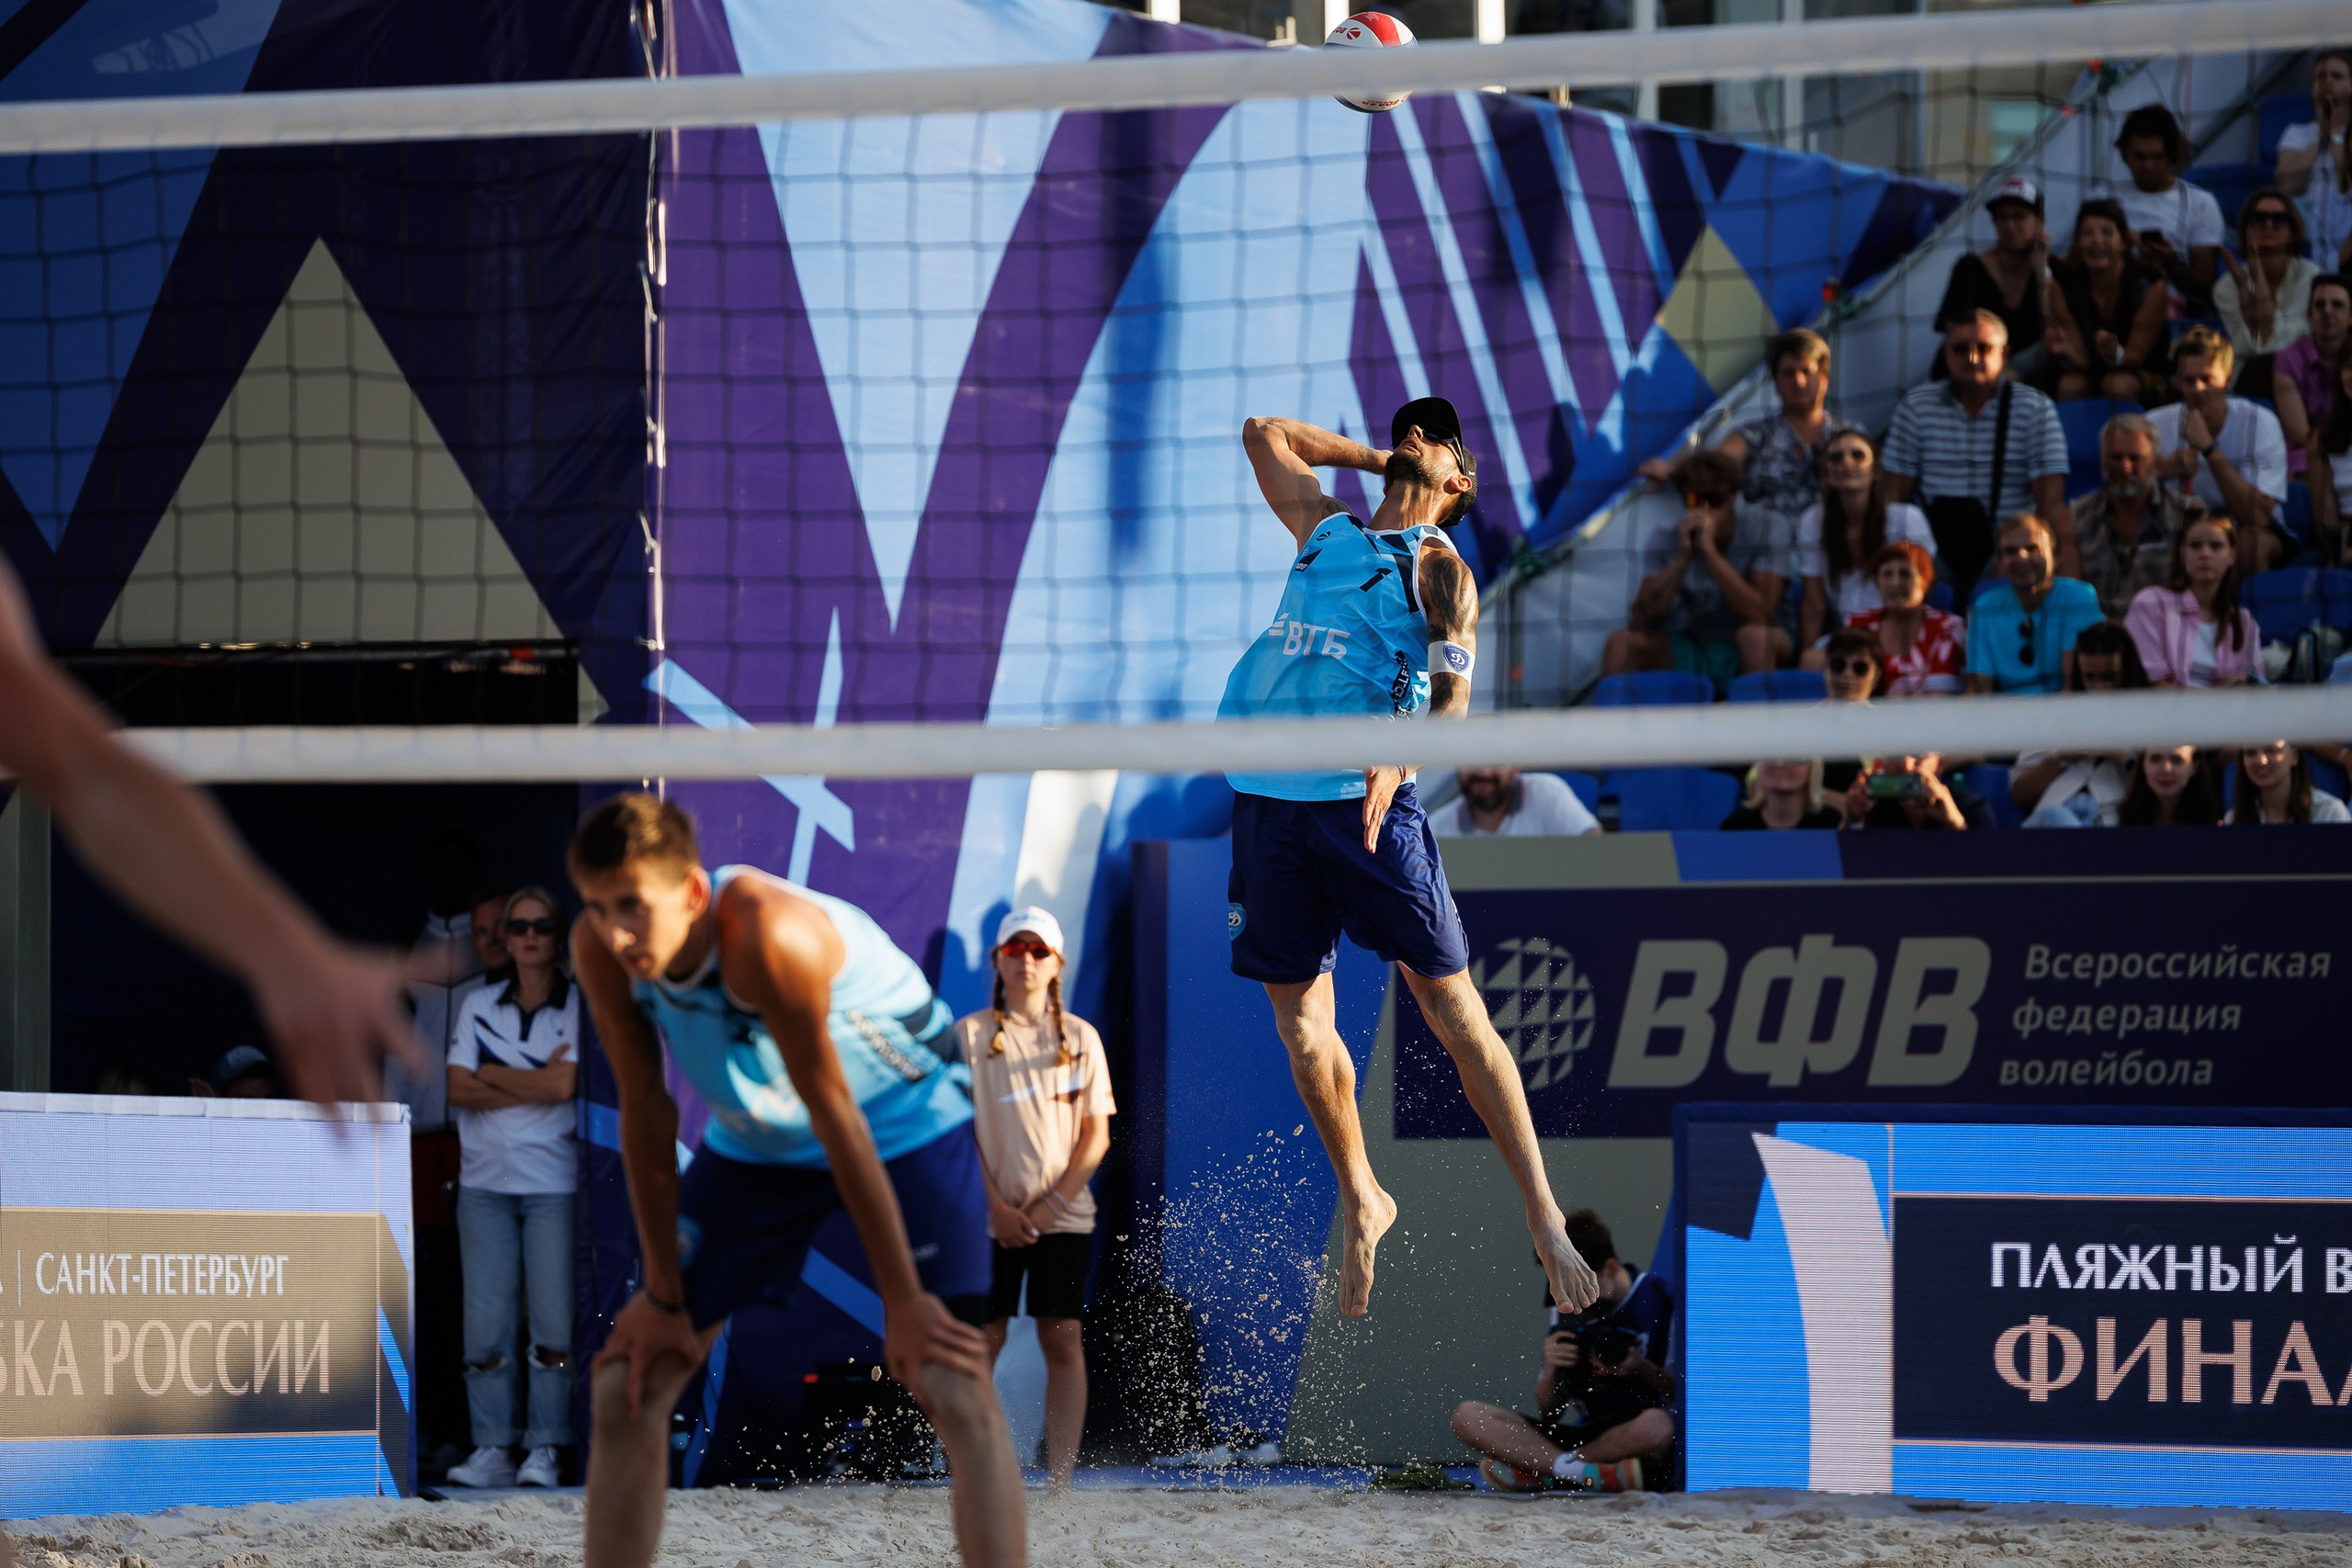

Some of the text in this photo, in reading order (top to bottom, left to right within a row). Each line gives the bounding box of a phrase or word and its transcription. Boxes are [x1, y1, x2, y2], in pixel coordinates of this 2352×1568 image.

[1359, 568, 1393, 592] 1
[1283, 621, 1351, 660] ВТБ
[2024, 944, 2332, 987] Всероссийская
[1607, 934, 1991, 1088] ВФВ
[2012, 998, 2243, 1039] федерация
[1998, 1049, 2214, 1086] волейбола
[35, 1252, 289, 1298] САНКТ-ПЕТЕРБУРГ
[1990, 1233, 2303, 1292] ПЛЯЖНЫЙ
[0, 1319, 330, 1397] КА РОССИИ
